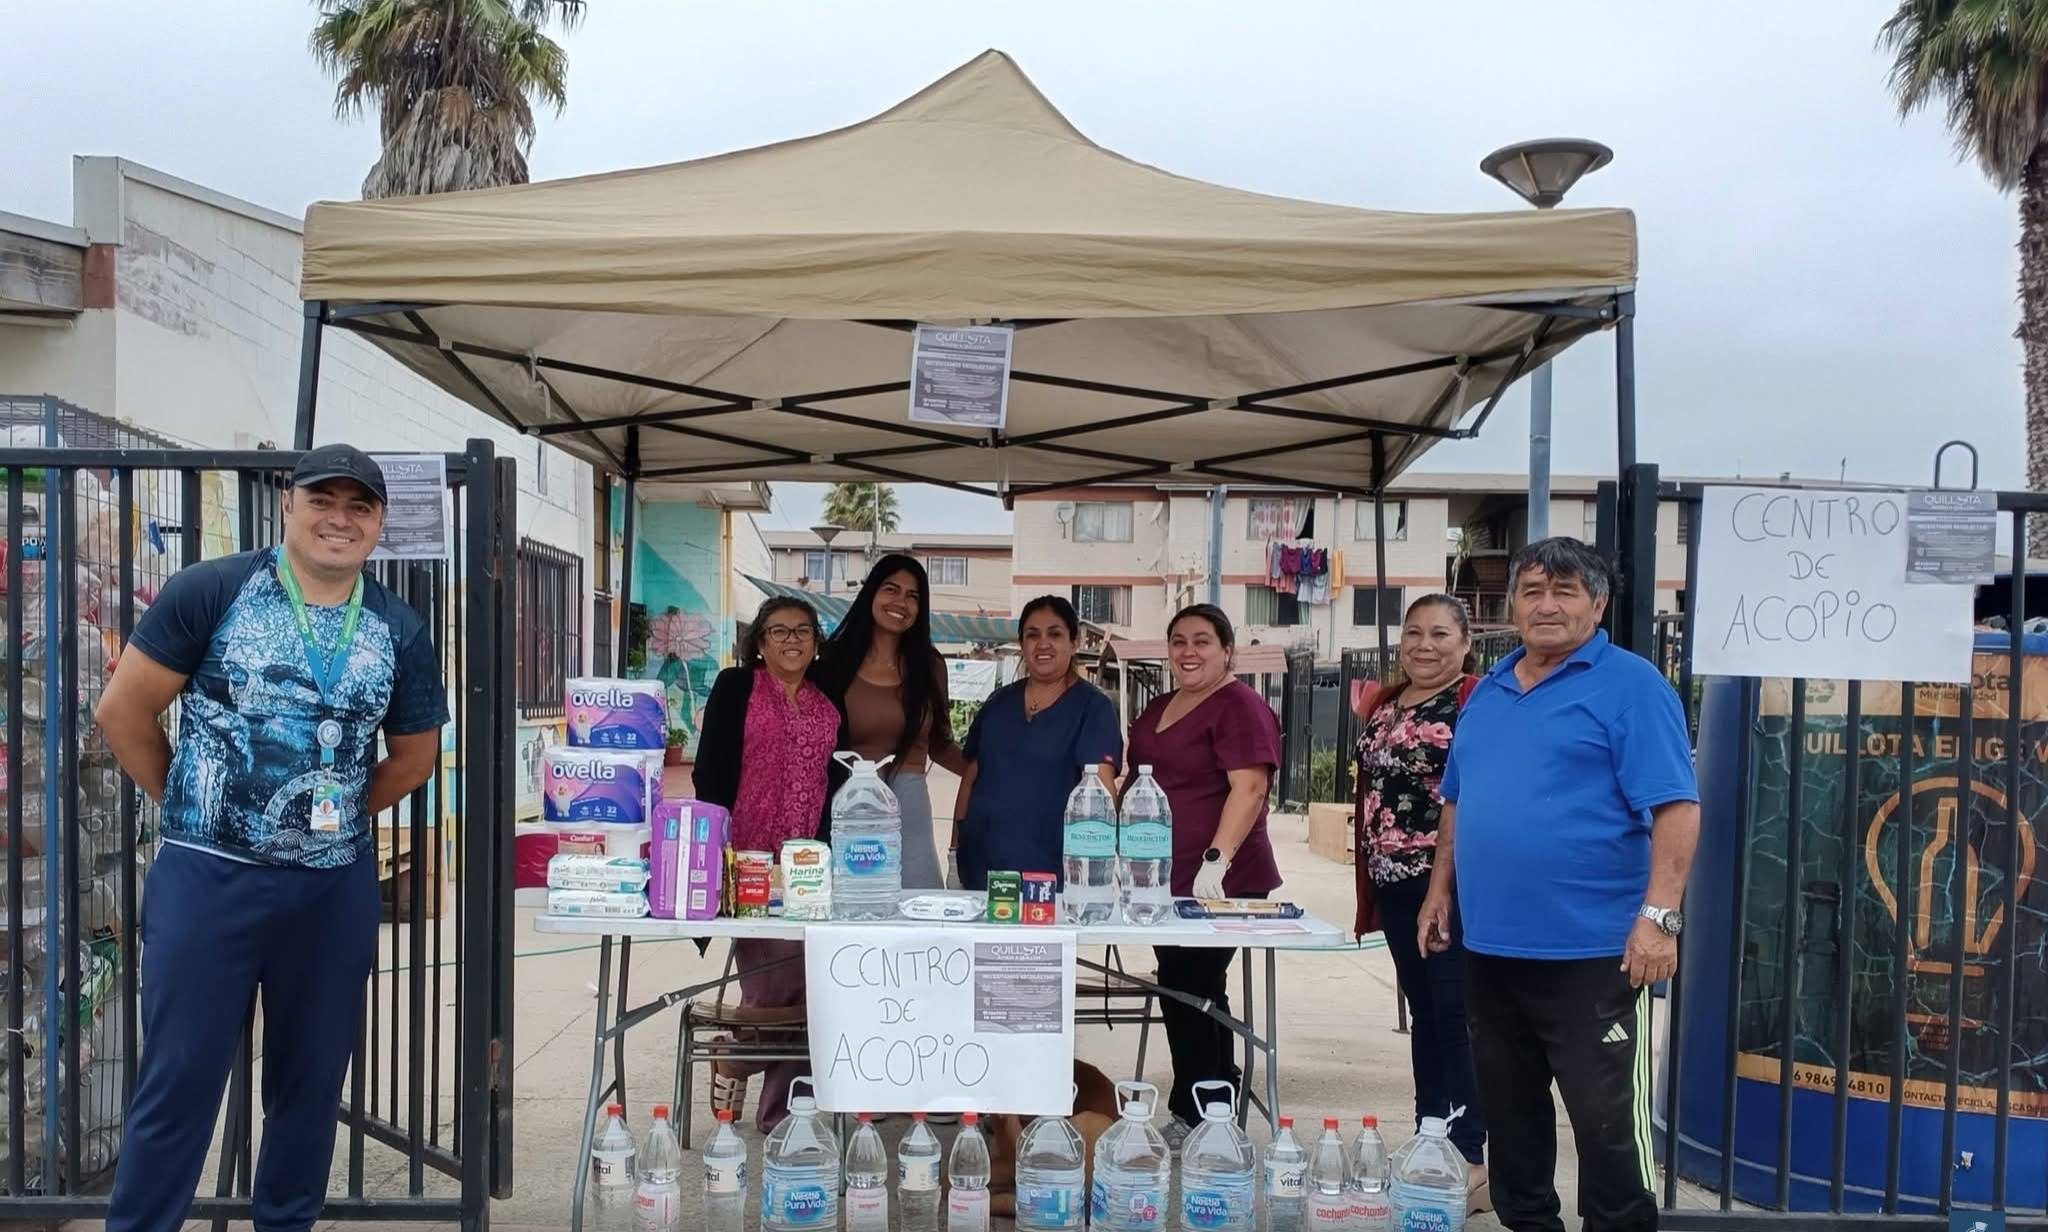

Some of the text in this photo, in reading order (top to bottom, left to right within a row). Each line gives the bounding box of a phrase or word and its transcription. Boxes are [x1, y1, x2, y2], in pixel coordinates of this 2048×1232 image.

[1732, 492, 1900, 542] CENTRO
[1787, 550, 1836, 580] DE
[571, 688, 634, 708] ovella
[552, 760, 616, 780] ovella
[845, 853, 865, 861] Pura
[789, 867, 825, 876] Harina
[878, 998, 916, 1024] DE
[784, 1199, 826, 1210] Pura Vida
[1186, 1202, 1228, 1216] Pura Vida
[1404, 1218, 1428, 1230] Pura
